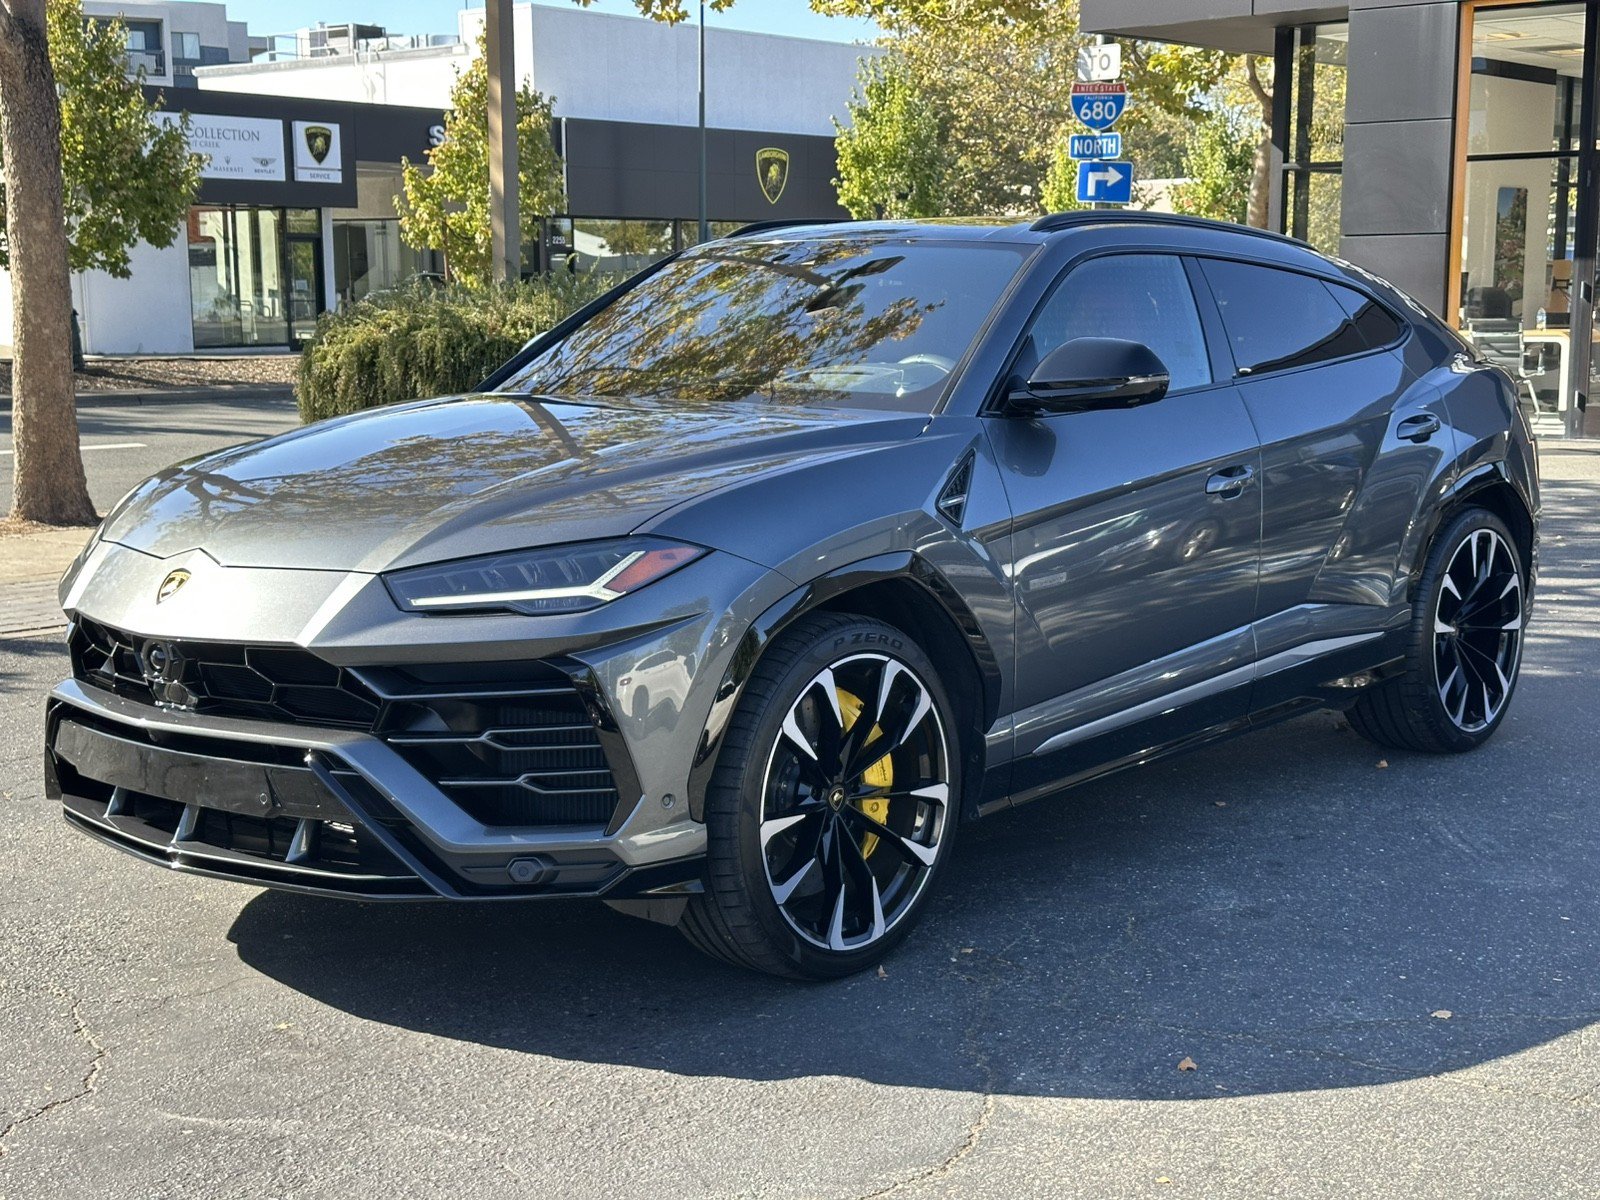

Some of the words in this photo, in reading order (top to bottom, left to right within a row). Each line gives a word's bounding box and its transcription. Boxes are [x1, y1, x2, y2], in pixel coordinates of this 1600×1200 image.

[1090, 53, 1111, 71] TO
[1076, 84, 1121, 93] INTERSTATE
[1080, 102, 1116, 120] 680
[1074, 138, 1116, 155] NORTH
[834, 637, 845, 651] P
[851, 632, 903, 650] ZERO
